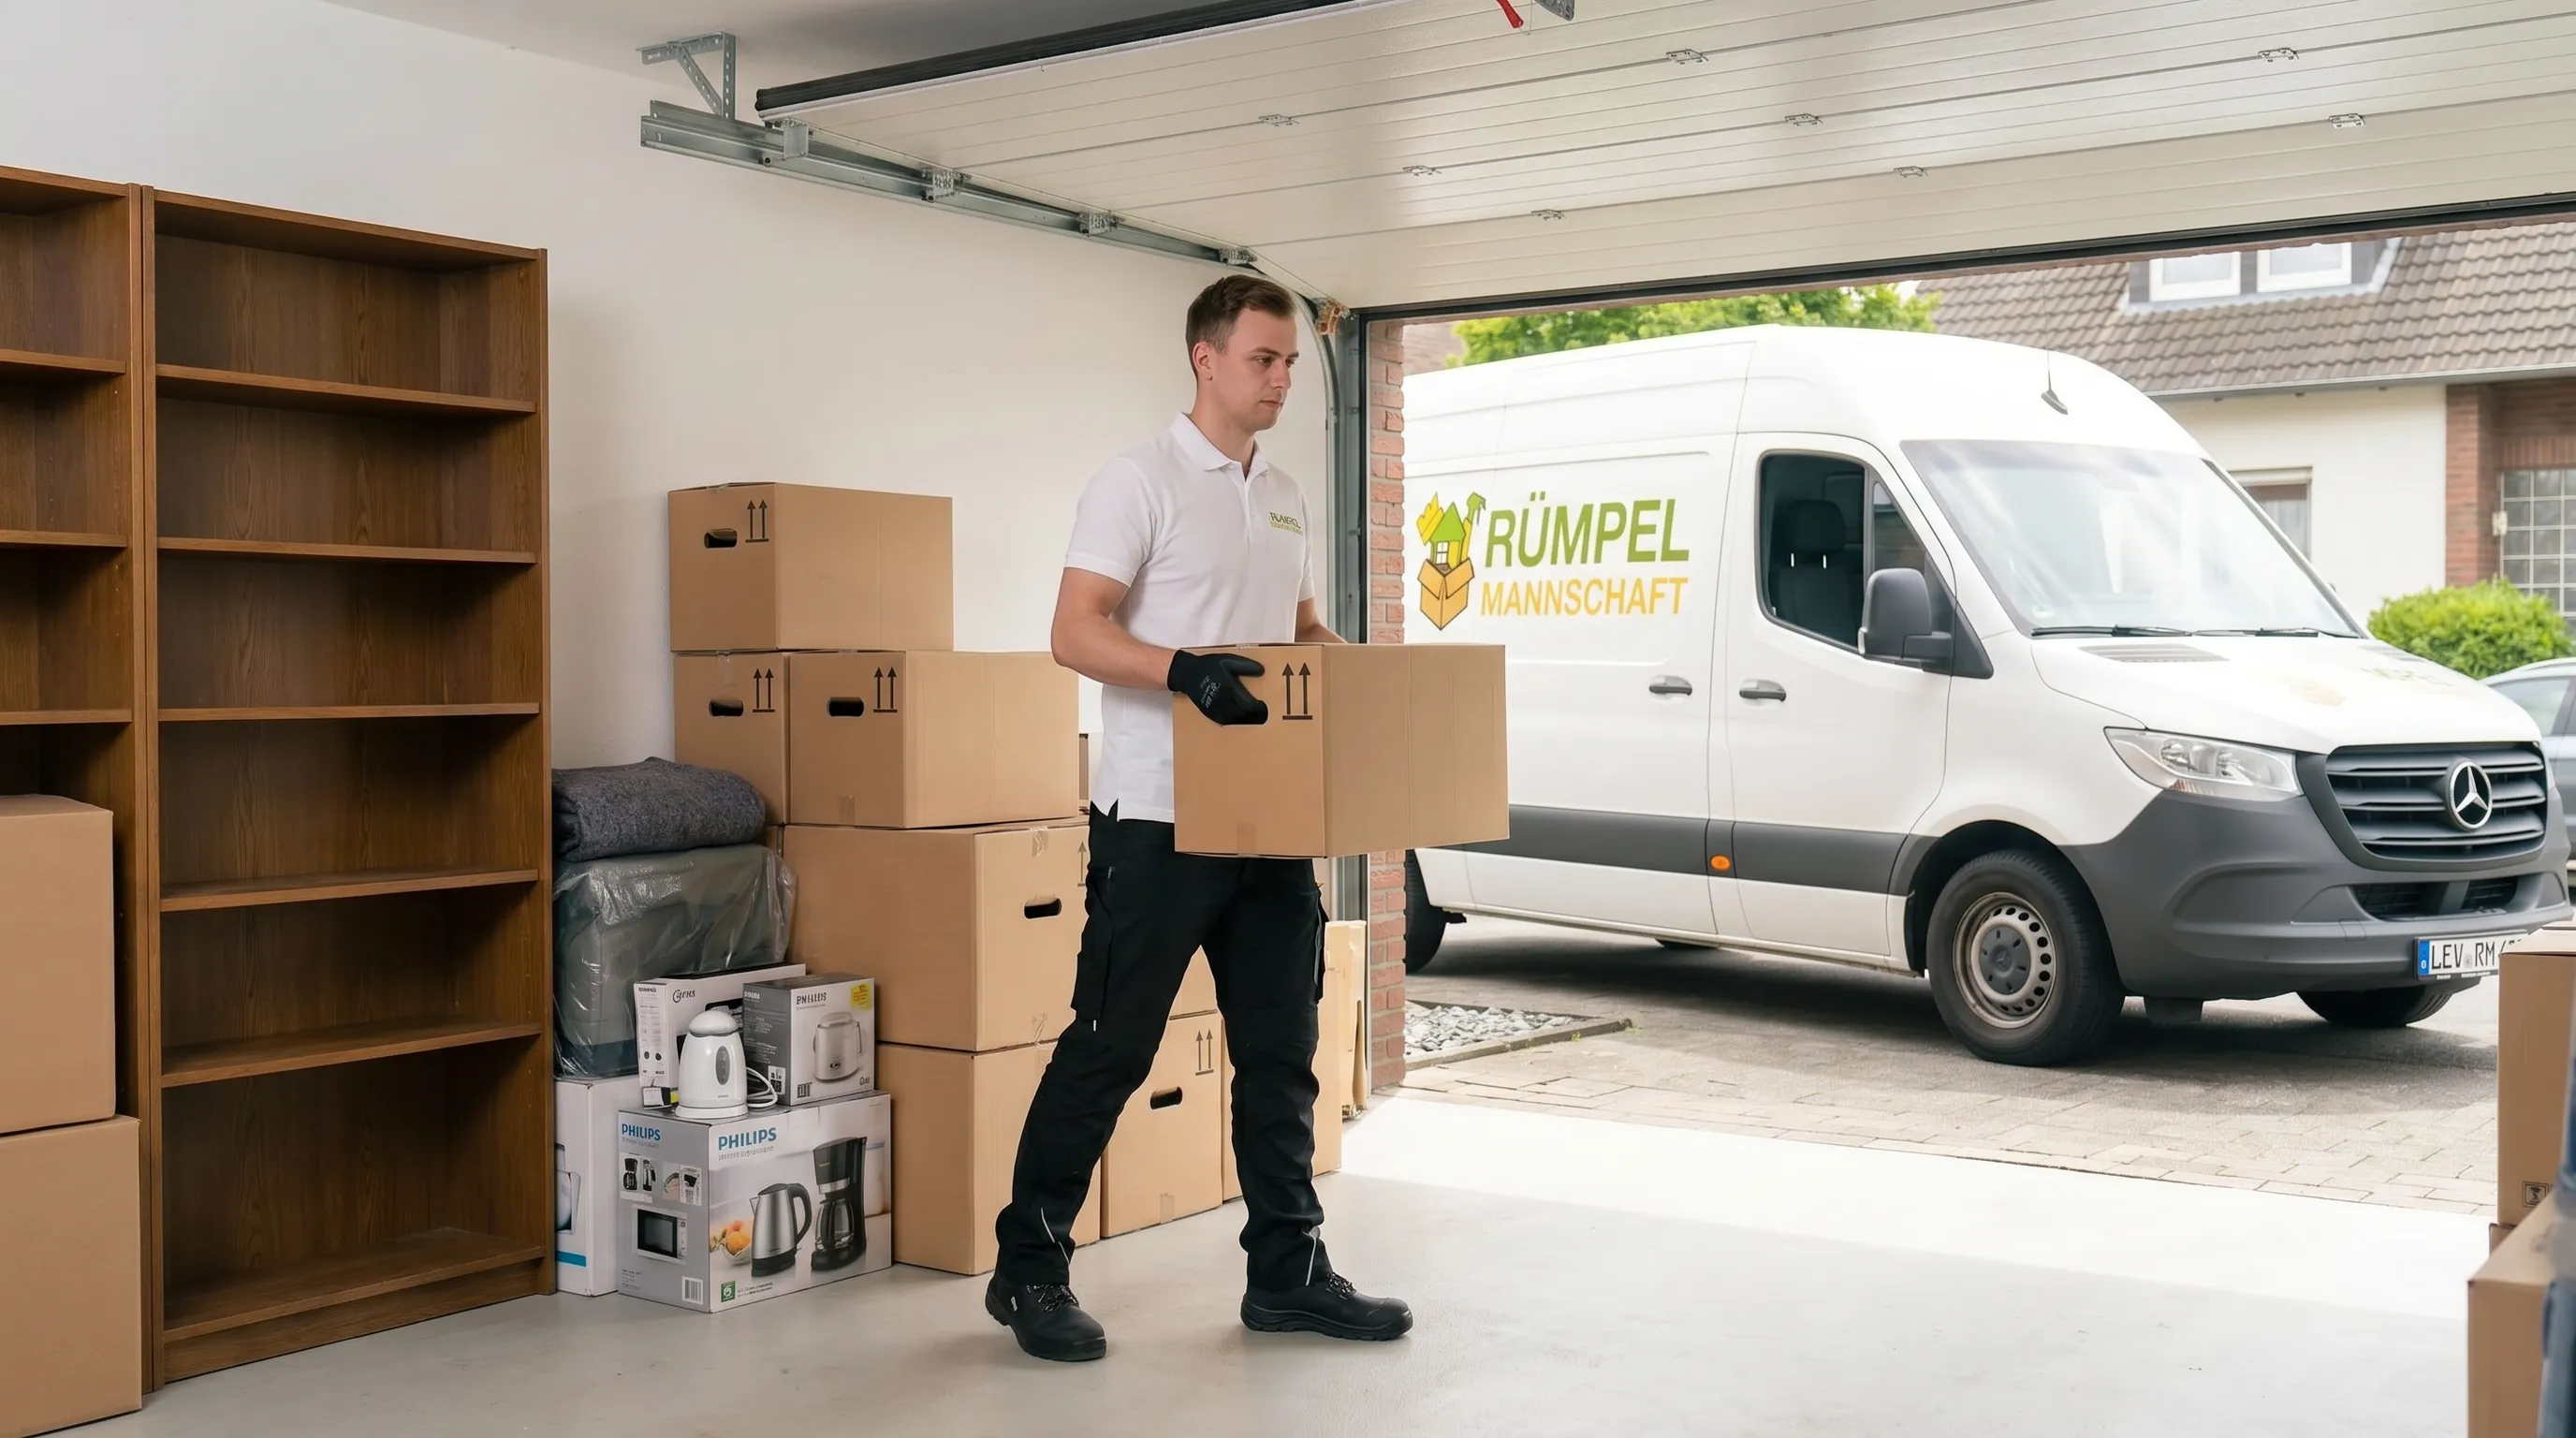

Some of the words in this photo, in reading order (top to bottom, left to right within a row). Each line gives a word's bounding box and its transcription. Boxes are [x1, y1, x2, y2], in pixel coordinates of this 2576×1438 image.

[1485, 492, 1690, 568] RÜMPEL
[1480, 577, 1689, 616] MANNSCHAFT
[2431, 943, 2464, 970] LEV
[2475, 941, 2496, 967] RM
[622, 1123, 661, 1141] PHILIPS
[718, 1127, 777, 1151] PHILIPS
